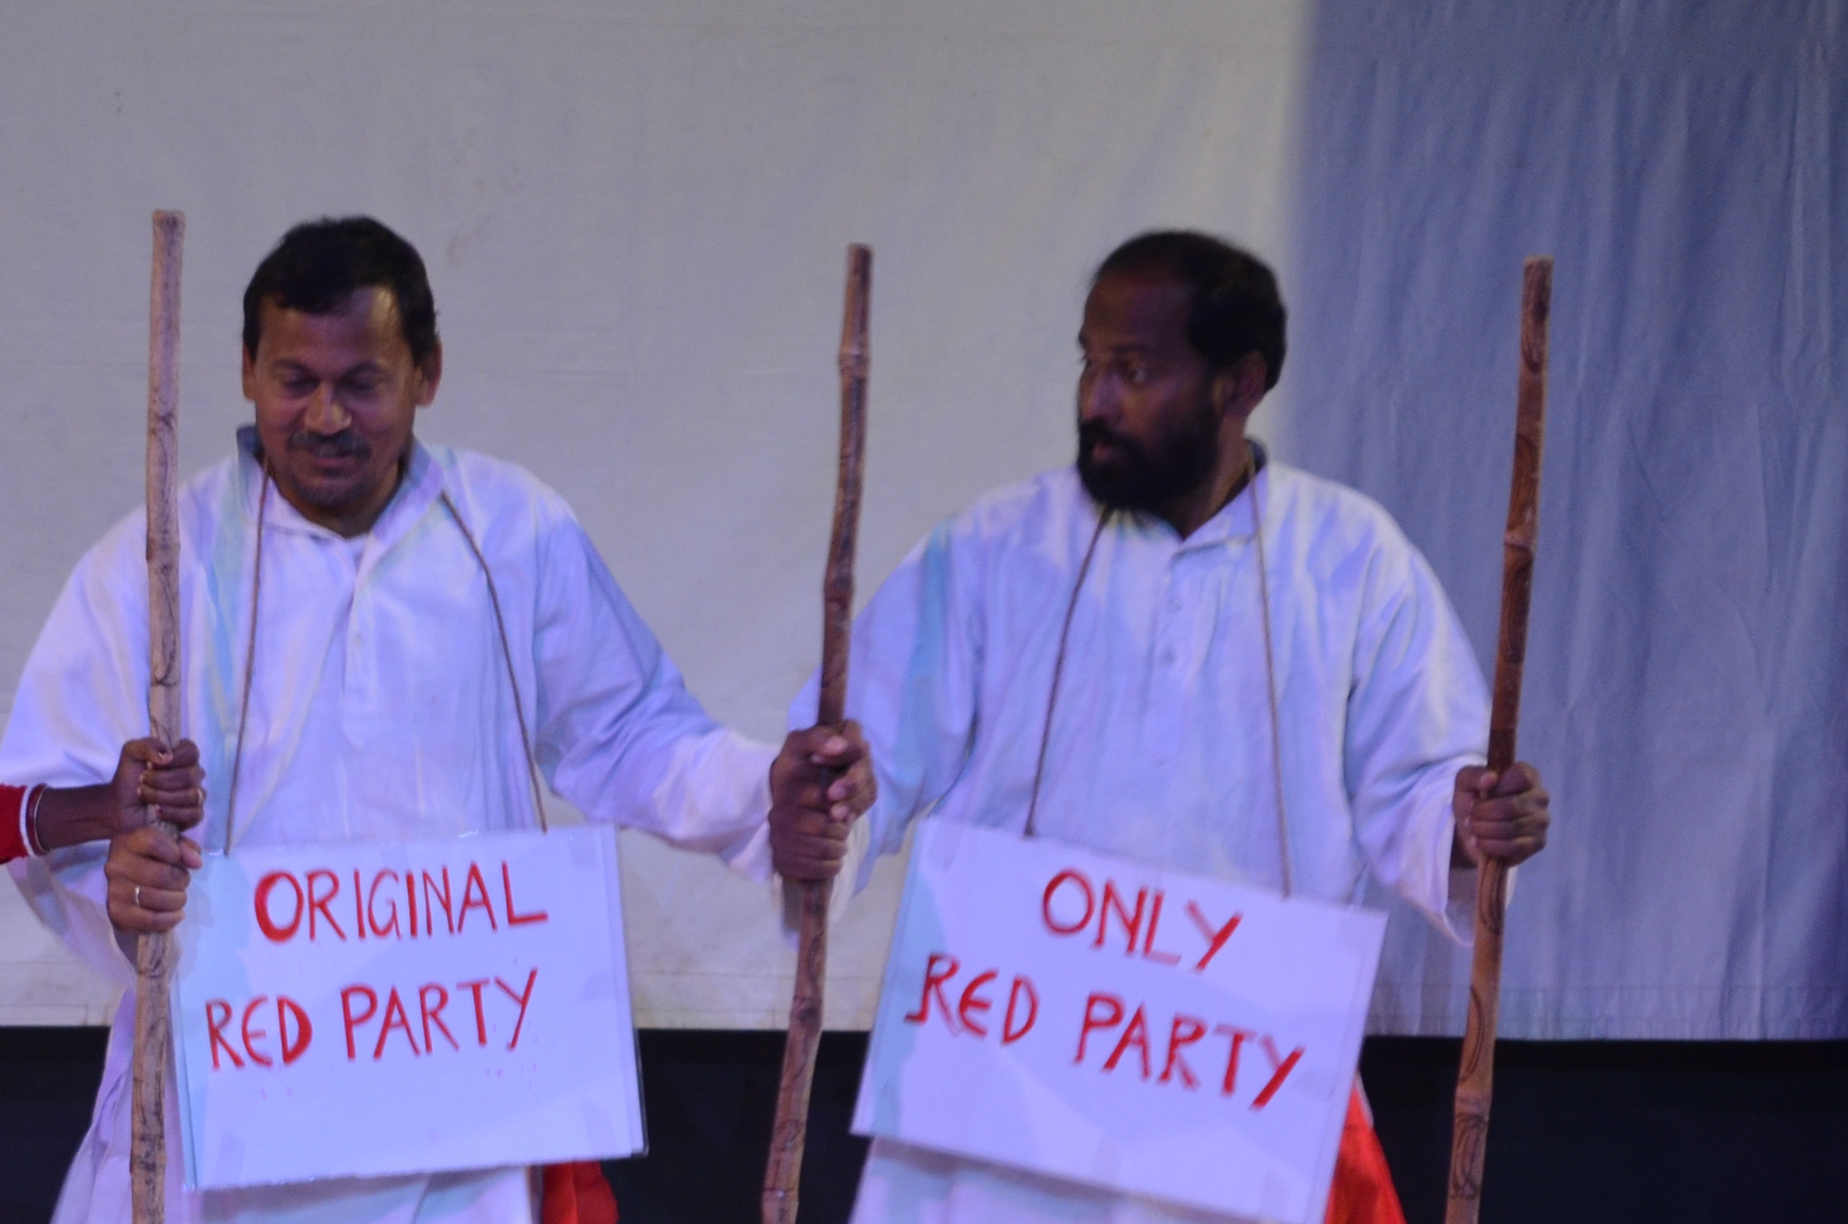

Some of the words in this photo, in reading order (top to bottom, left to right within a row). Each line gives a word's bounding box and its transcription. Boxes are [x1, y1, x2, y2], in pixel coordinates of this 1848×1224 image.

[254, 860, 548, 942] ORIGINAL
[1041, 867, 1243, 972] ONLY
[205, 995, 312, 1070] RED
[340, 967, 538, 1060] PARTY
[904, 952, 1038, 1046] RED
[1071, 991, 1307, 1111] PARTY
